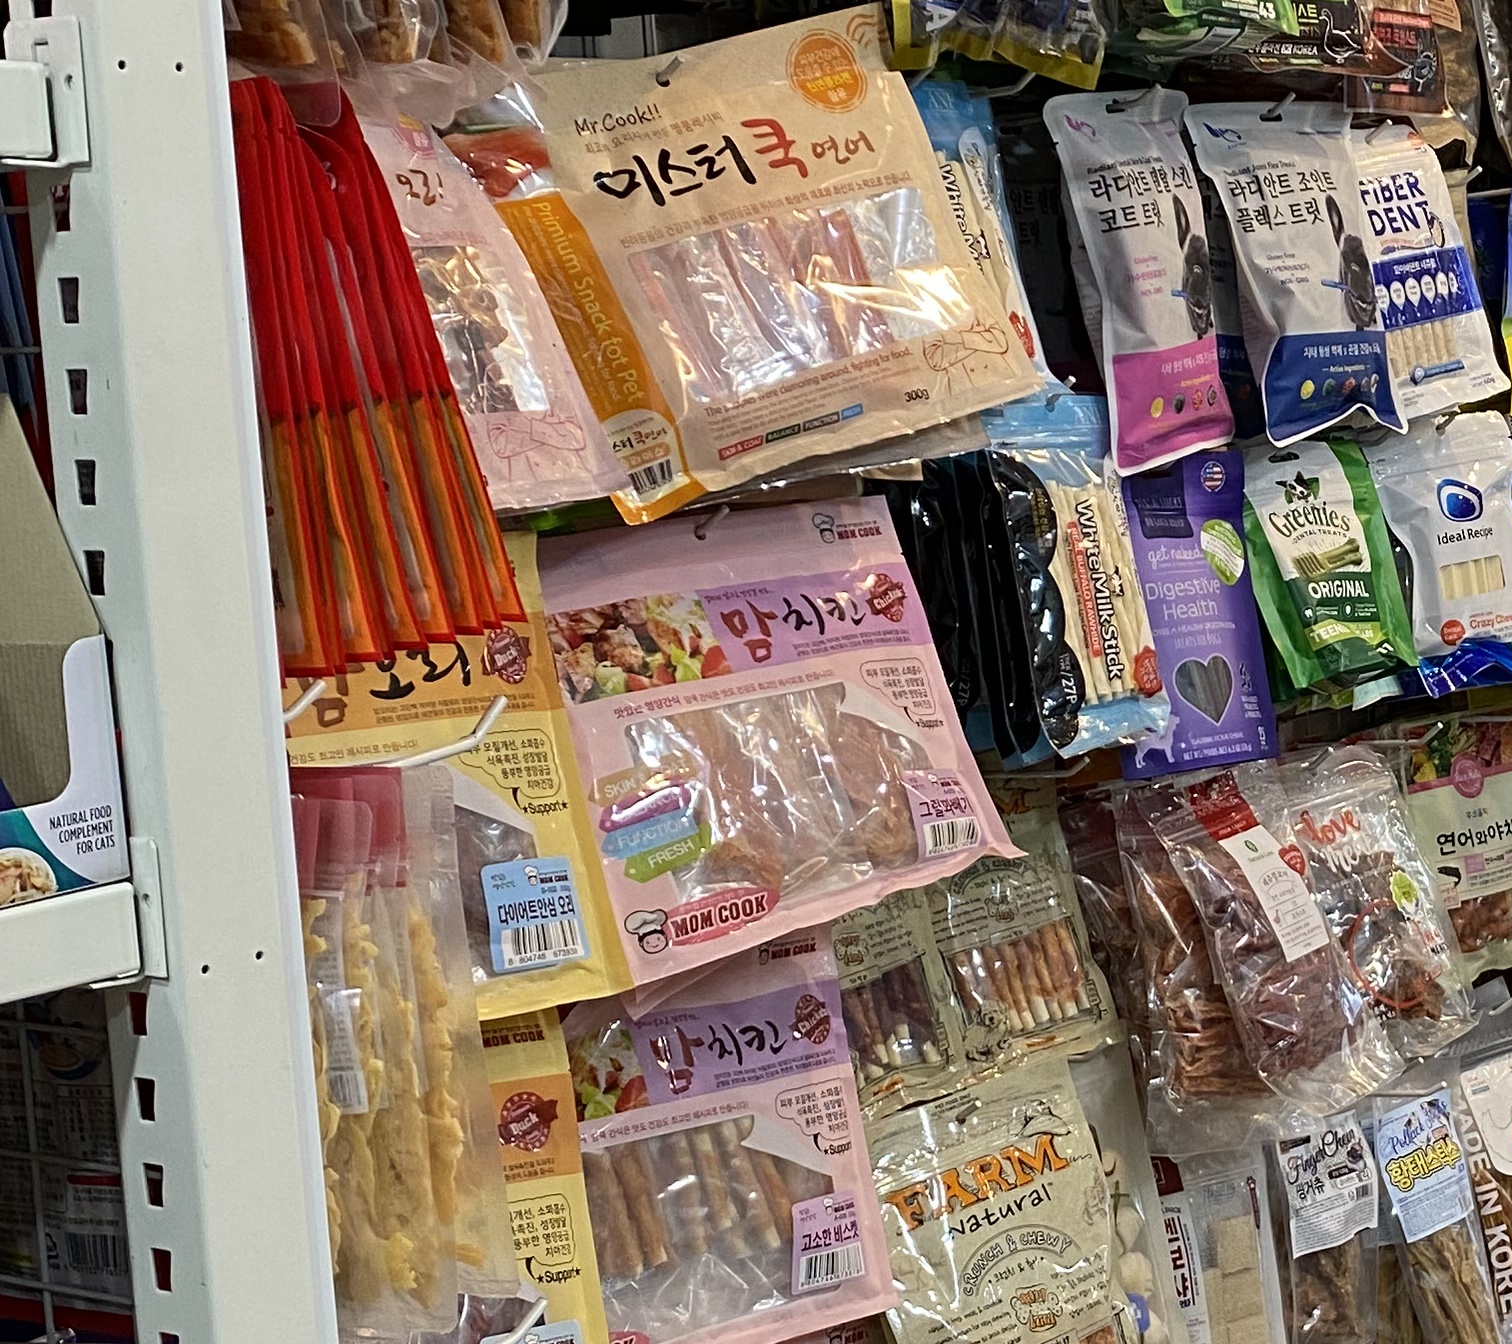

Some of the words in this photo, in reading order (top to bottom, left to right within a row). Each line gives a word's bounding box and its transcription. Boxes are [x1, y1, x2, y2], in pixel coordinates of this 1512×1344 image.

[574, 104, 662, 137] Mr.Cook!!
[811, 131, 876, 164] 연어
[1089, 169, 1149, 202] 라디안트
[1228, 171, 1295, 203] 라디안트
[1298, 170, 1338, 191] 조인트
[1359, 172, 1427, 206] FIBER
[1099, 208, 1141, 234] 코트
[1290, 198, 1326, 225] 트릿
[1366, 201, 1432, 237] DENT
[573, 275, 613, 339] Snack
[805, 414, 839, 430] FUNCTION
[1268, 501, 1351, 538] Greenies
[836, 527, 858, 541] MOM
[858, 525, 883, 539] COOK
[1437, 529, 1467, 546] Ideal
[1467, 526, 1494, 543] Recipe
[872, 588, 906, 610] Chicken
[1145, 574, 1222, 603] Digestive
[1308, 579, 1370, 600] ORIGINAL
[1162, 599, 1219, 622] Health
[1469, 618, 1495, 631] Crazy
[493, 646, 519, 666] Duck
[643, 695, 682, 713] 영양간식
[486, 754, 519, 768] 식욕촉진,
[521, 752, 549, 765] 성장발달
[500, 766, 523, 778] 풍부한
[523, 764, 551, 777] 영양공급
[526, 779, 554, 791] 치아건강
[49, 810, 89, 830] NATURAL
[89, 804, 113, 823] FOOD
[528, 800, 563, 817] Support
[58, 820, 114, 844] COMPLEMENT
[616, 818, 688, 851] FUNCTION
[76, 840, 94, 856] FOR
[94, 835, 116, 852] CATS
[646, 837, 695, 869] FRESH
[497, 896, 557, 926] 다이어트안심
[670, 907, 713, 940] MOM
[714, 892, 769, 926] COOK
[512, 1028, 545, 1044] COOK
[509, 1112, 540, 1136] Duck
[887, 1134, 1071, 1233] FARM
[1474, 1184, 1503, 1217] IN
[801, 1228, 832, 1252] 고소한
[544, 1267, 576, 1285] Support
[963, 1241, 1004, 1297] CRUNCH
[1019, 1230, 1073, 1254] CHEWY
